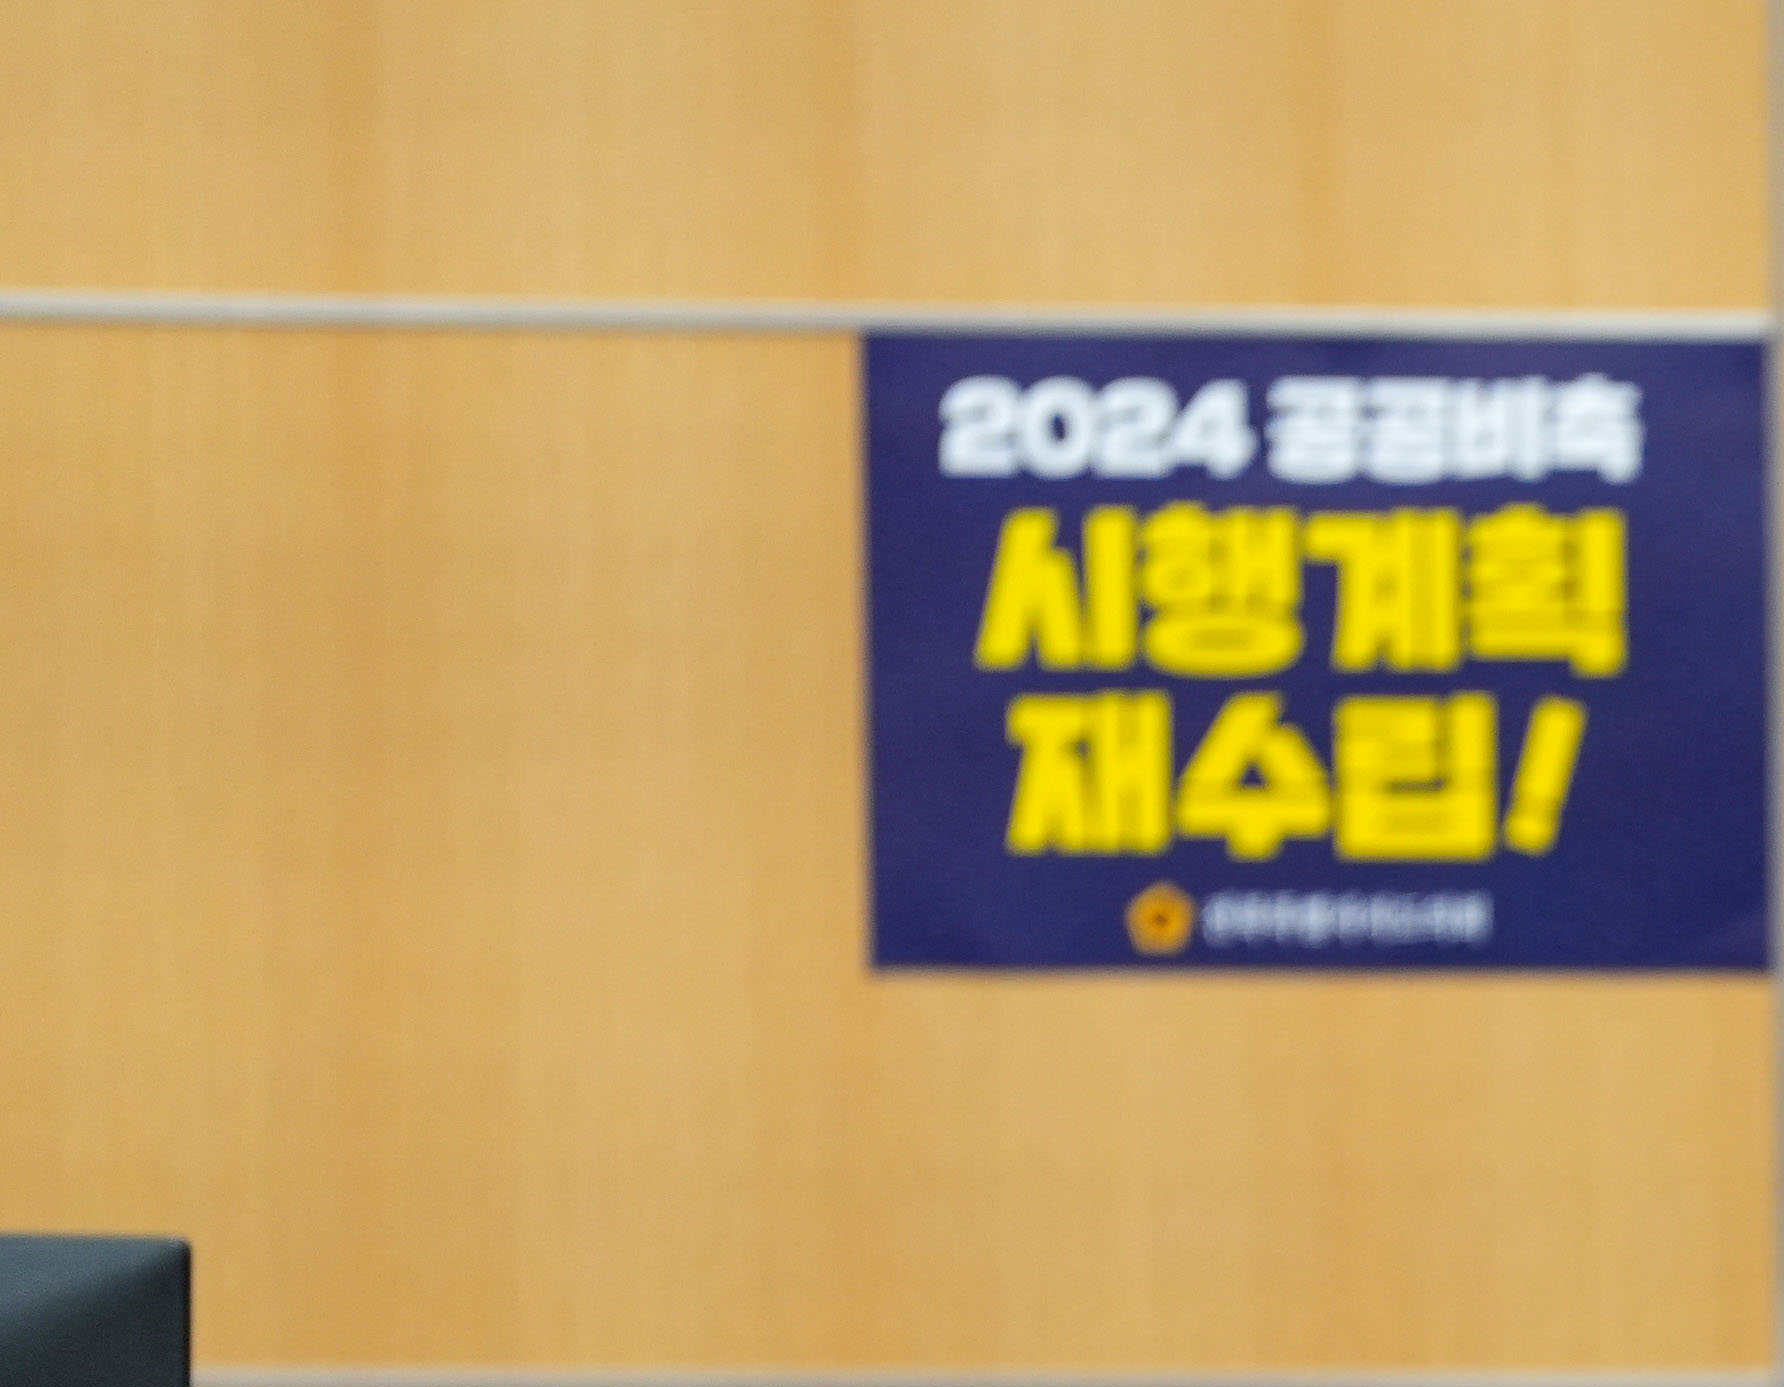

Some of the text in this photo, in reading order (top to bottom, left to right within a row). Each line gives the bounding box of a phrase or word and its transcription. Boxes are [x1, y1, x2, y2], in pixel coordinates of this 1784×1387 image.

[941, 379, 1252, 475] 2024
[979, 504, 1624, 675] 시행계획
[1010, 693, 1582, 858] 재수립!
